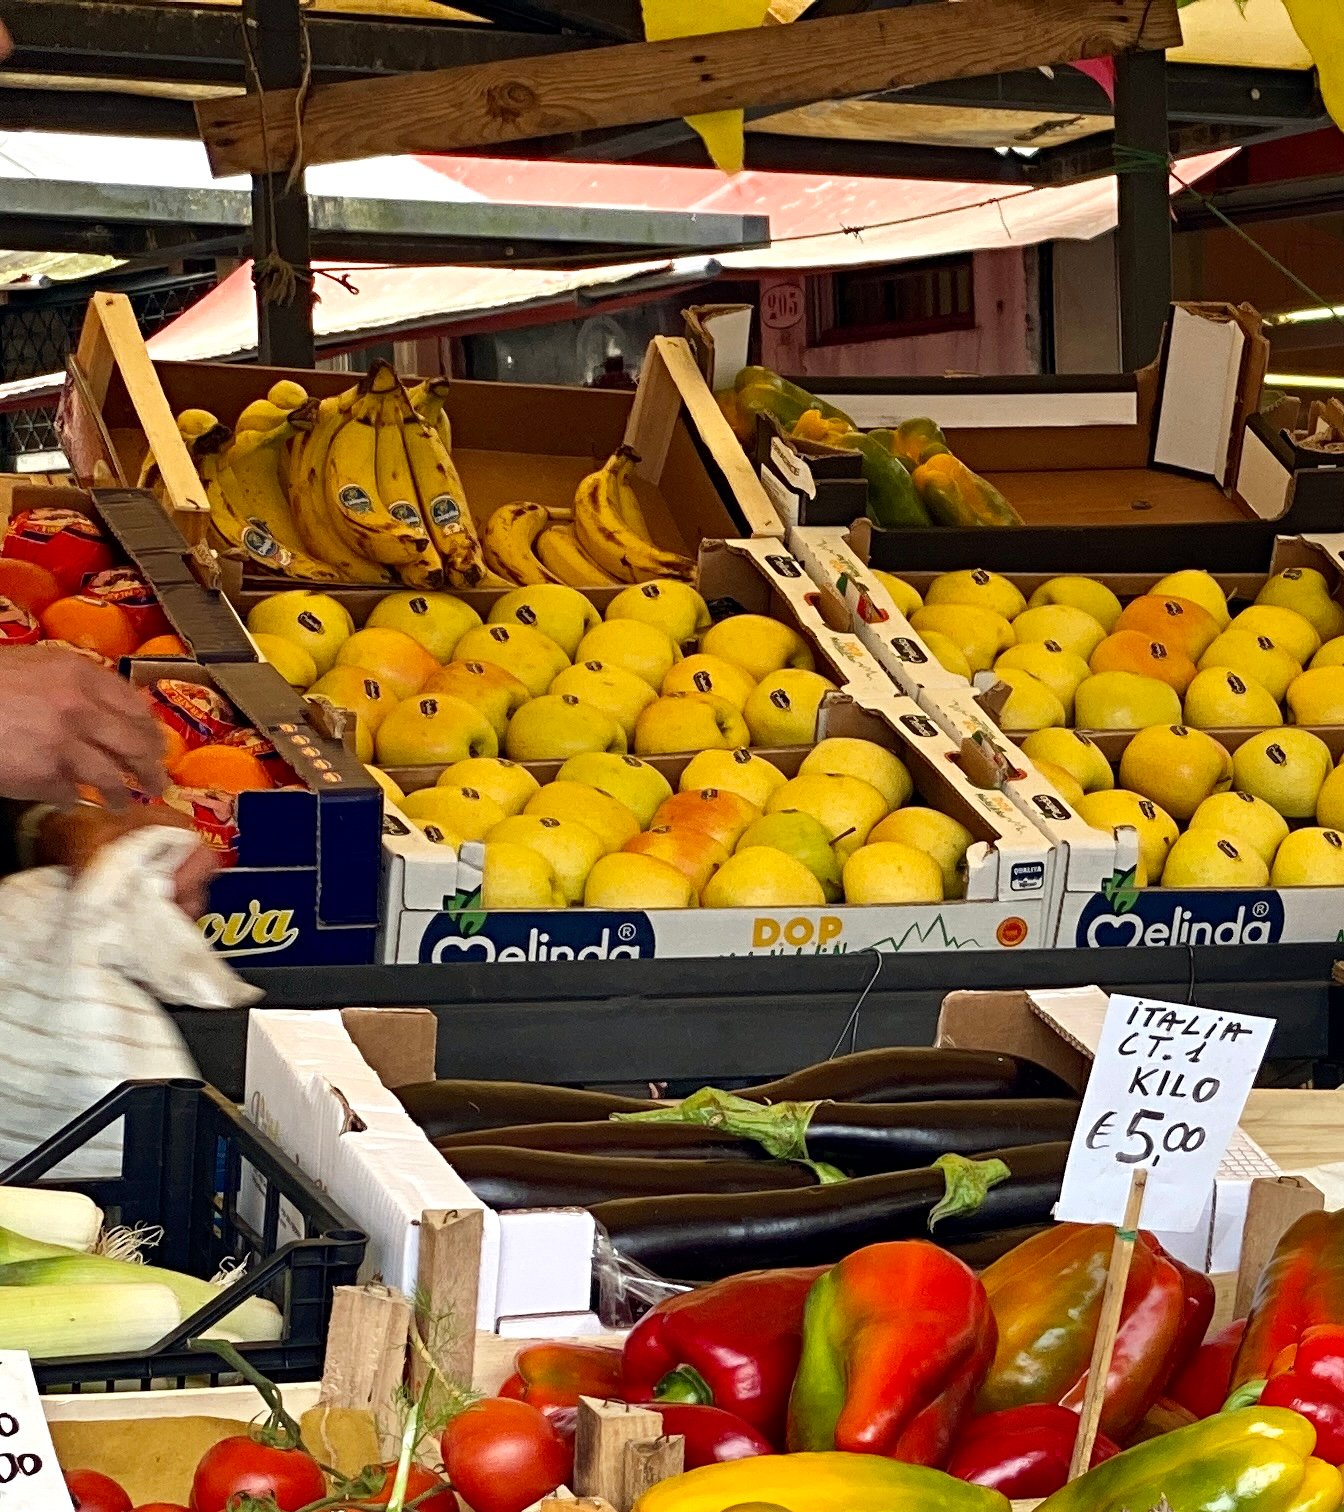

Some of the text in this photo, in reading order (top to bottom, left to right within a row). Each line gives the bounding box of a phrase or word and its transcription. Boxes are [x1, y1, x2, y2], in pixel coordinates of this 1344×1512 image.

[432, 928, 641, 963] Melinda
[1087, 906, 1272, 948] Melinda
[1128, 1066, 1221, 1103] KILO
